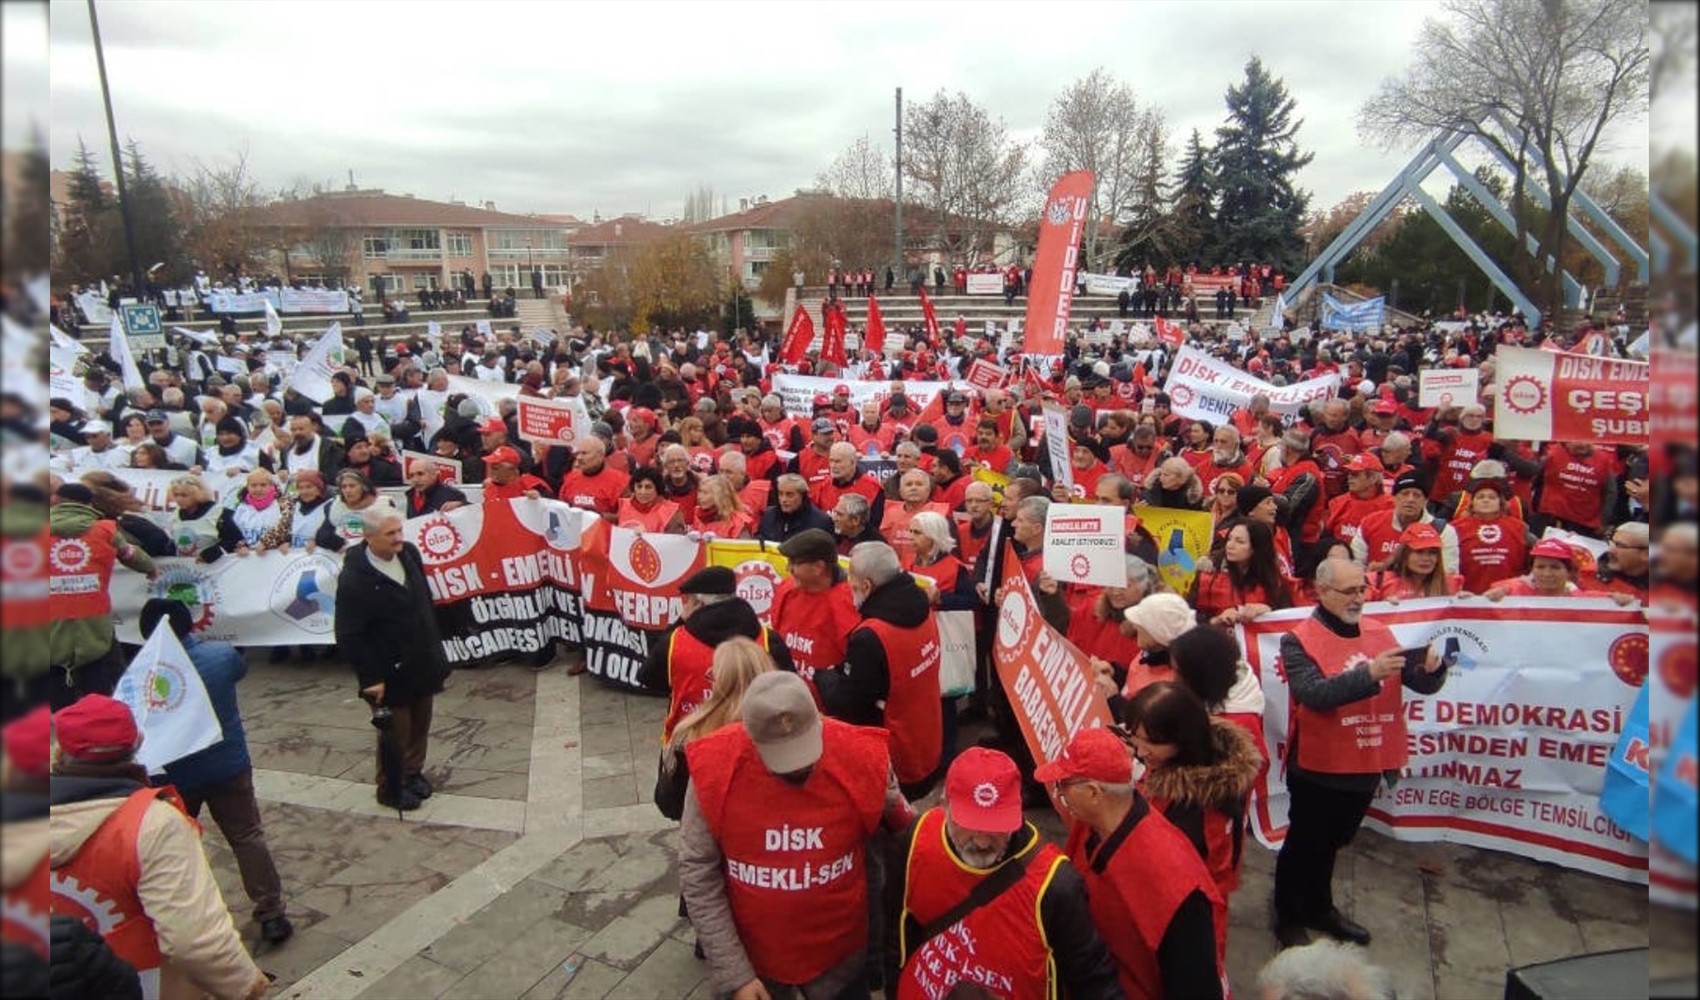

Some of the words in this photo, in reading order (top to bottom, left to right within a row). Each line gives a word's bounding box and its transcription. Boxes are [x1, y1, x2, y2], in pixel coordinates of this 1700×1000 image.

[1178, 357, 1220, 384] DİSK
[1609, 361, 1649, 381] EME
[1568, 388, 1649, 415] ÇEŞ
[740, 584, 772, 601] DİSK
[785, 632, 815, 655] DİSK
[1436, 700, 1622, 734] DEMOKRASİ
[1538, 736, 1616, 767] EME
[1396, 787, 1424, 806] SEN
[1429, 789, 1460, 809] EGE
[1465, 793, 1525, 817] BÖLGE
[765, 824, 824, 852] DİSK
[727, 851, 854, 891] EMEKLİ-SEN
